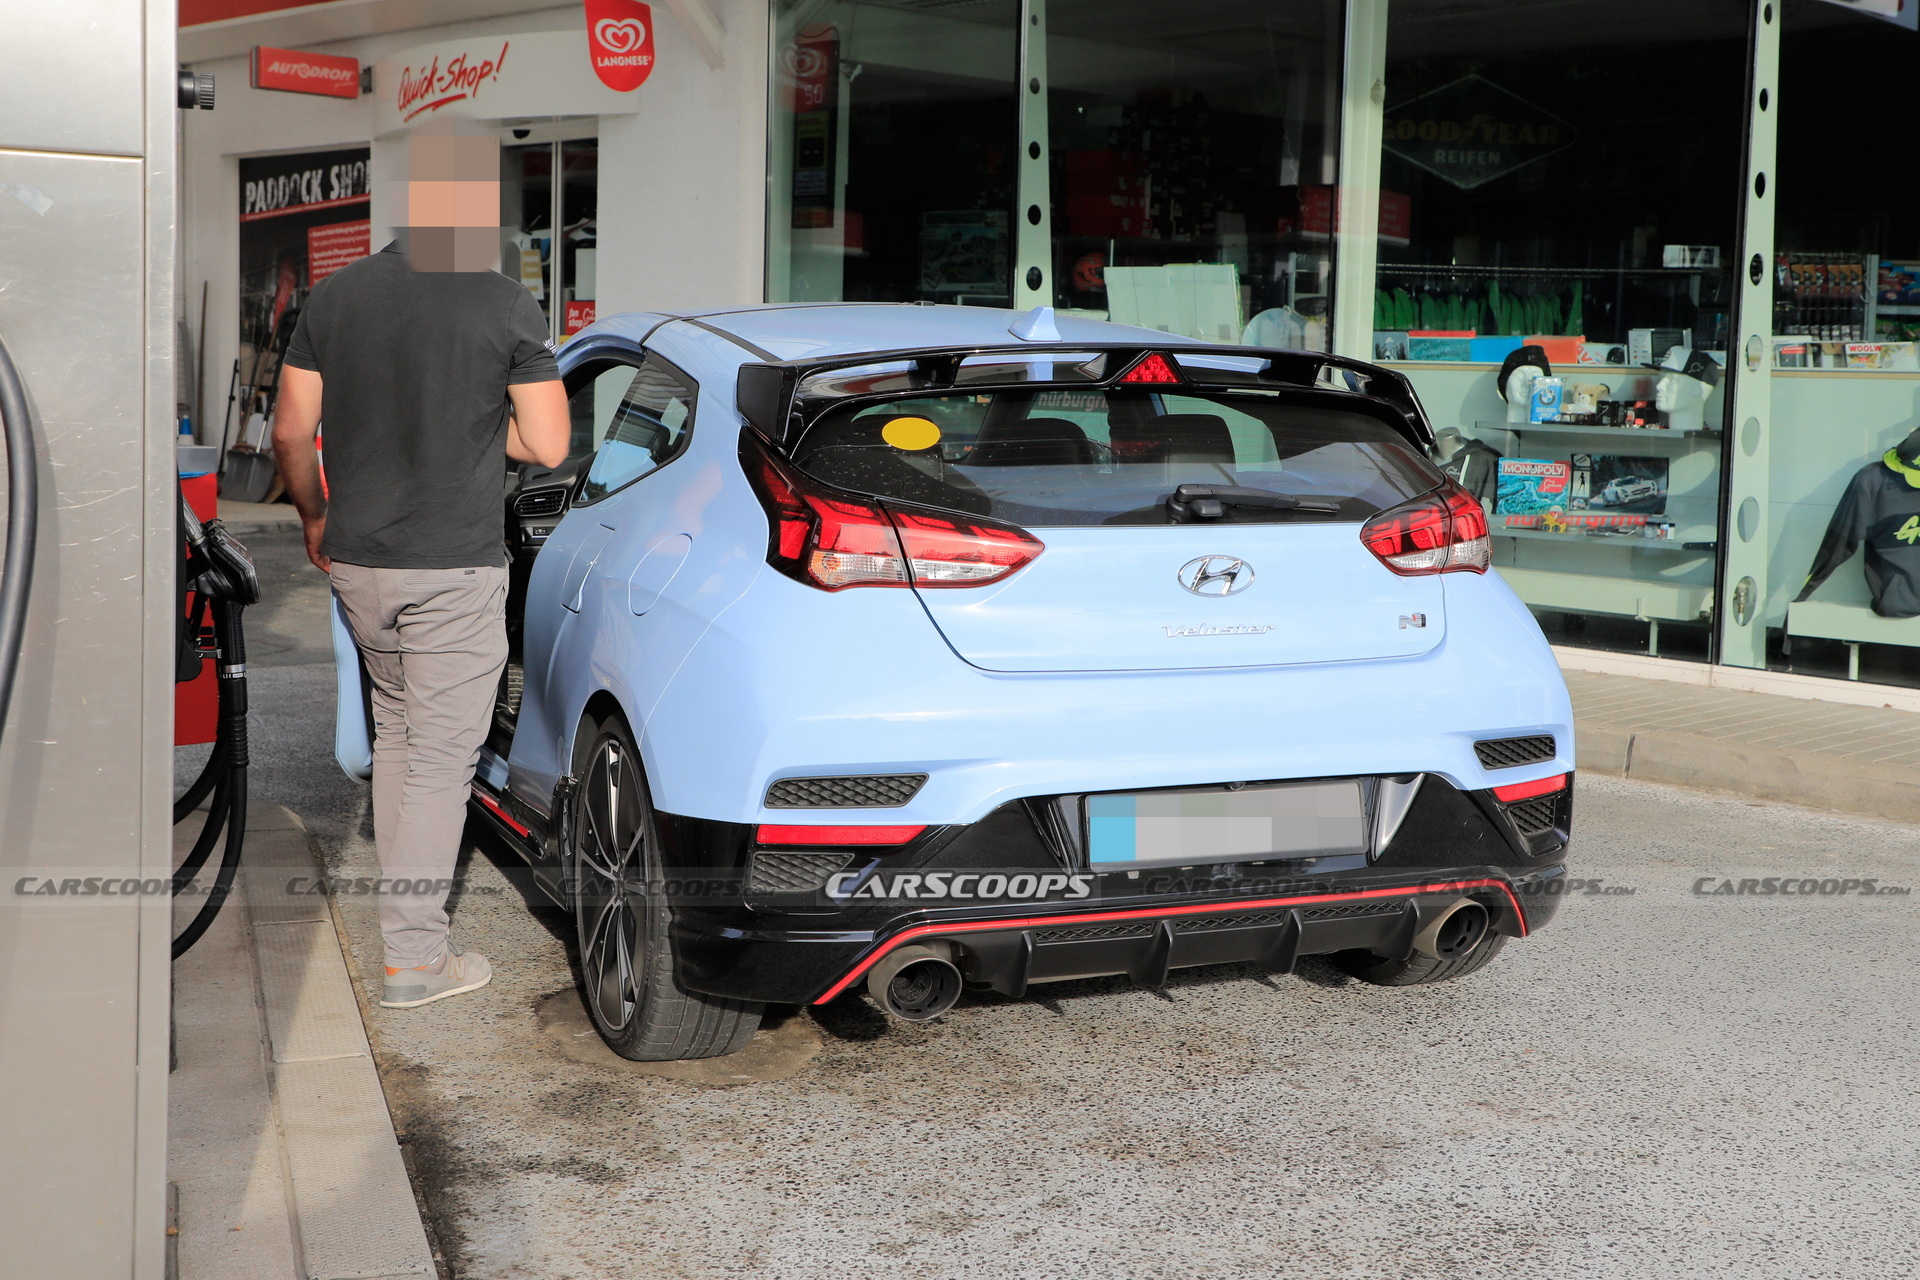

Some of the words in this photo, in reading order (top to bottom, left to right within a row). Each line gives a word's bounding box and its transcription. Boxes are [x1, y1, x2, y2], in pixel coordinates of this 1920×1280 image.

[597, 56, 648, 67] LANGNESE
[267, 62, 353, 80] AUTODROM
[398, 41, 509, 111] Quick-Shop!
[1435, 150, 1501, 165] REIFEN
[245, 168, 323, 215] PADDOCK
[1504, 463, 1564, 476] MONOPOLY
[1162, 623, 1276, 637] Veloster
